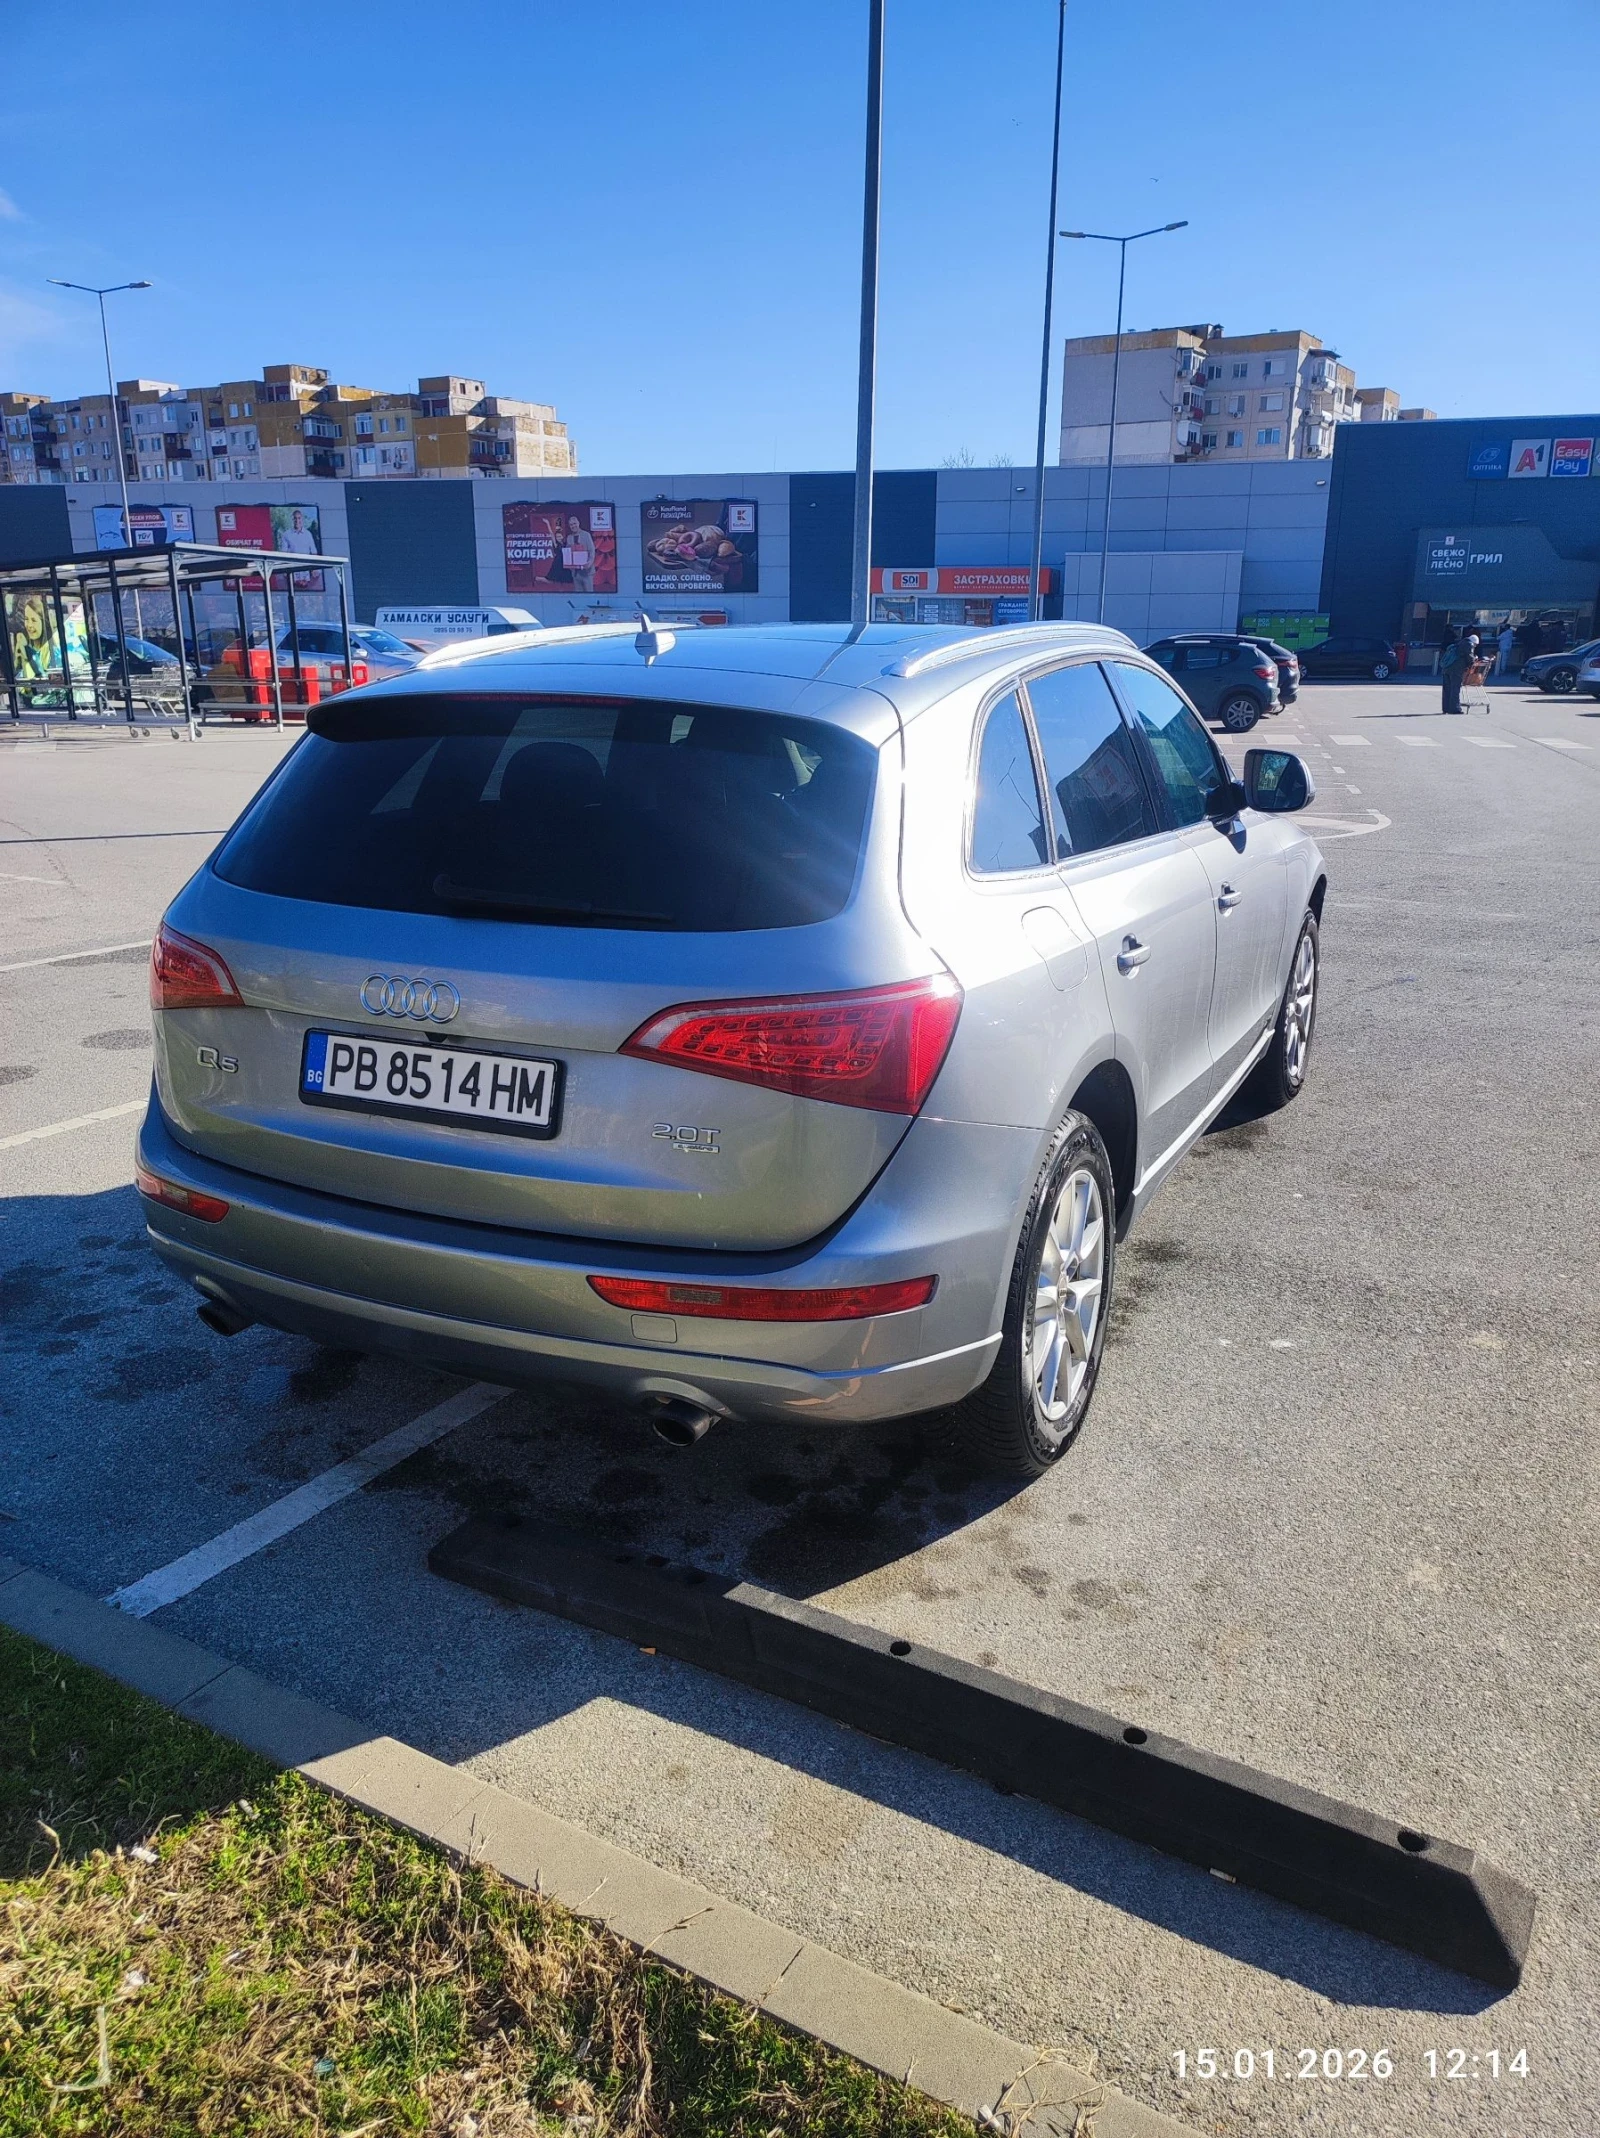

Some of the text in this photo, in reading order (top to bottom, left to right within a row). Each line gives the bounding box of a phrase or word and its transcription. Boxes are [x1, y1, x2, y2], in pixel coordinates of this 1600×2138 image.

[1515, 444, 1545, 472] A1
[1556, 446, 1589, 460] Easy
[1555, 460, 1580, 473] Pay
[507, 549, 554, 560] КОЛЕДА
[1431, 549, 1466, 557] СВЕЖО
[1469, 553, 1503, 563] ГРИЛ
[1430, 560, 1464, 569] ЛЕСНО
[645, 574, 679, 582] СЛАДКО.
[902, 575, 918, 584] SDI
[678, 582, 724, 590] ПРОВЕРЕНО.
[383, 613, 489, 624] ХАМАЛСКИ УСЛУГИ
[197, 1046, 239, 1073] Q5
[307, 1069, 323, 1084] BG
[329, 1043, 546, 1116] PB 8514 HM
[651, 1122, 721, 1144] 2.0T
